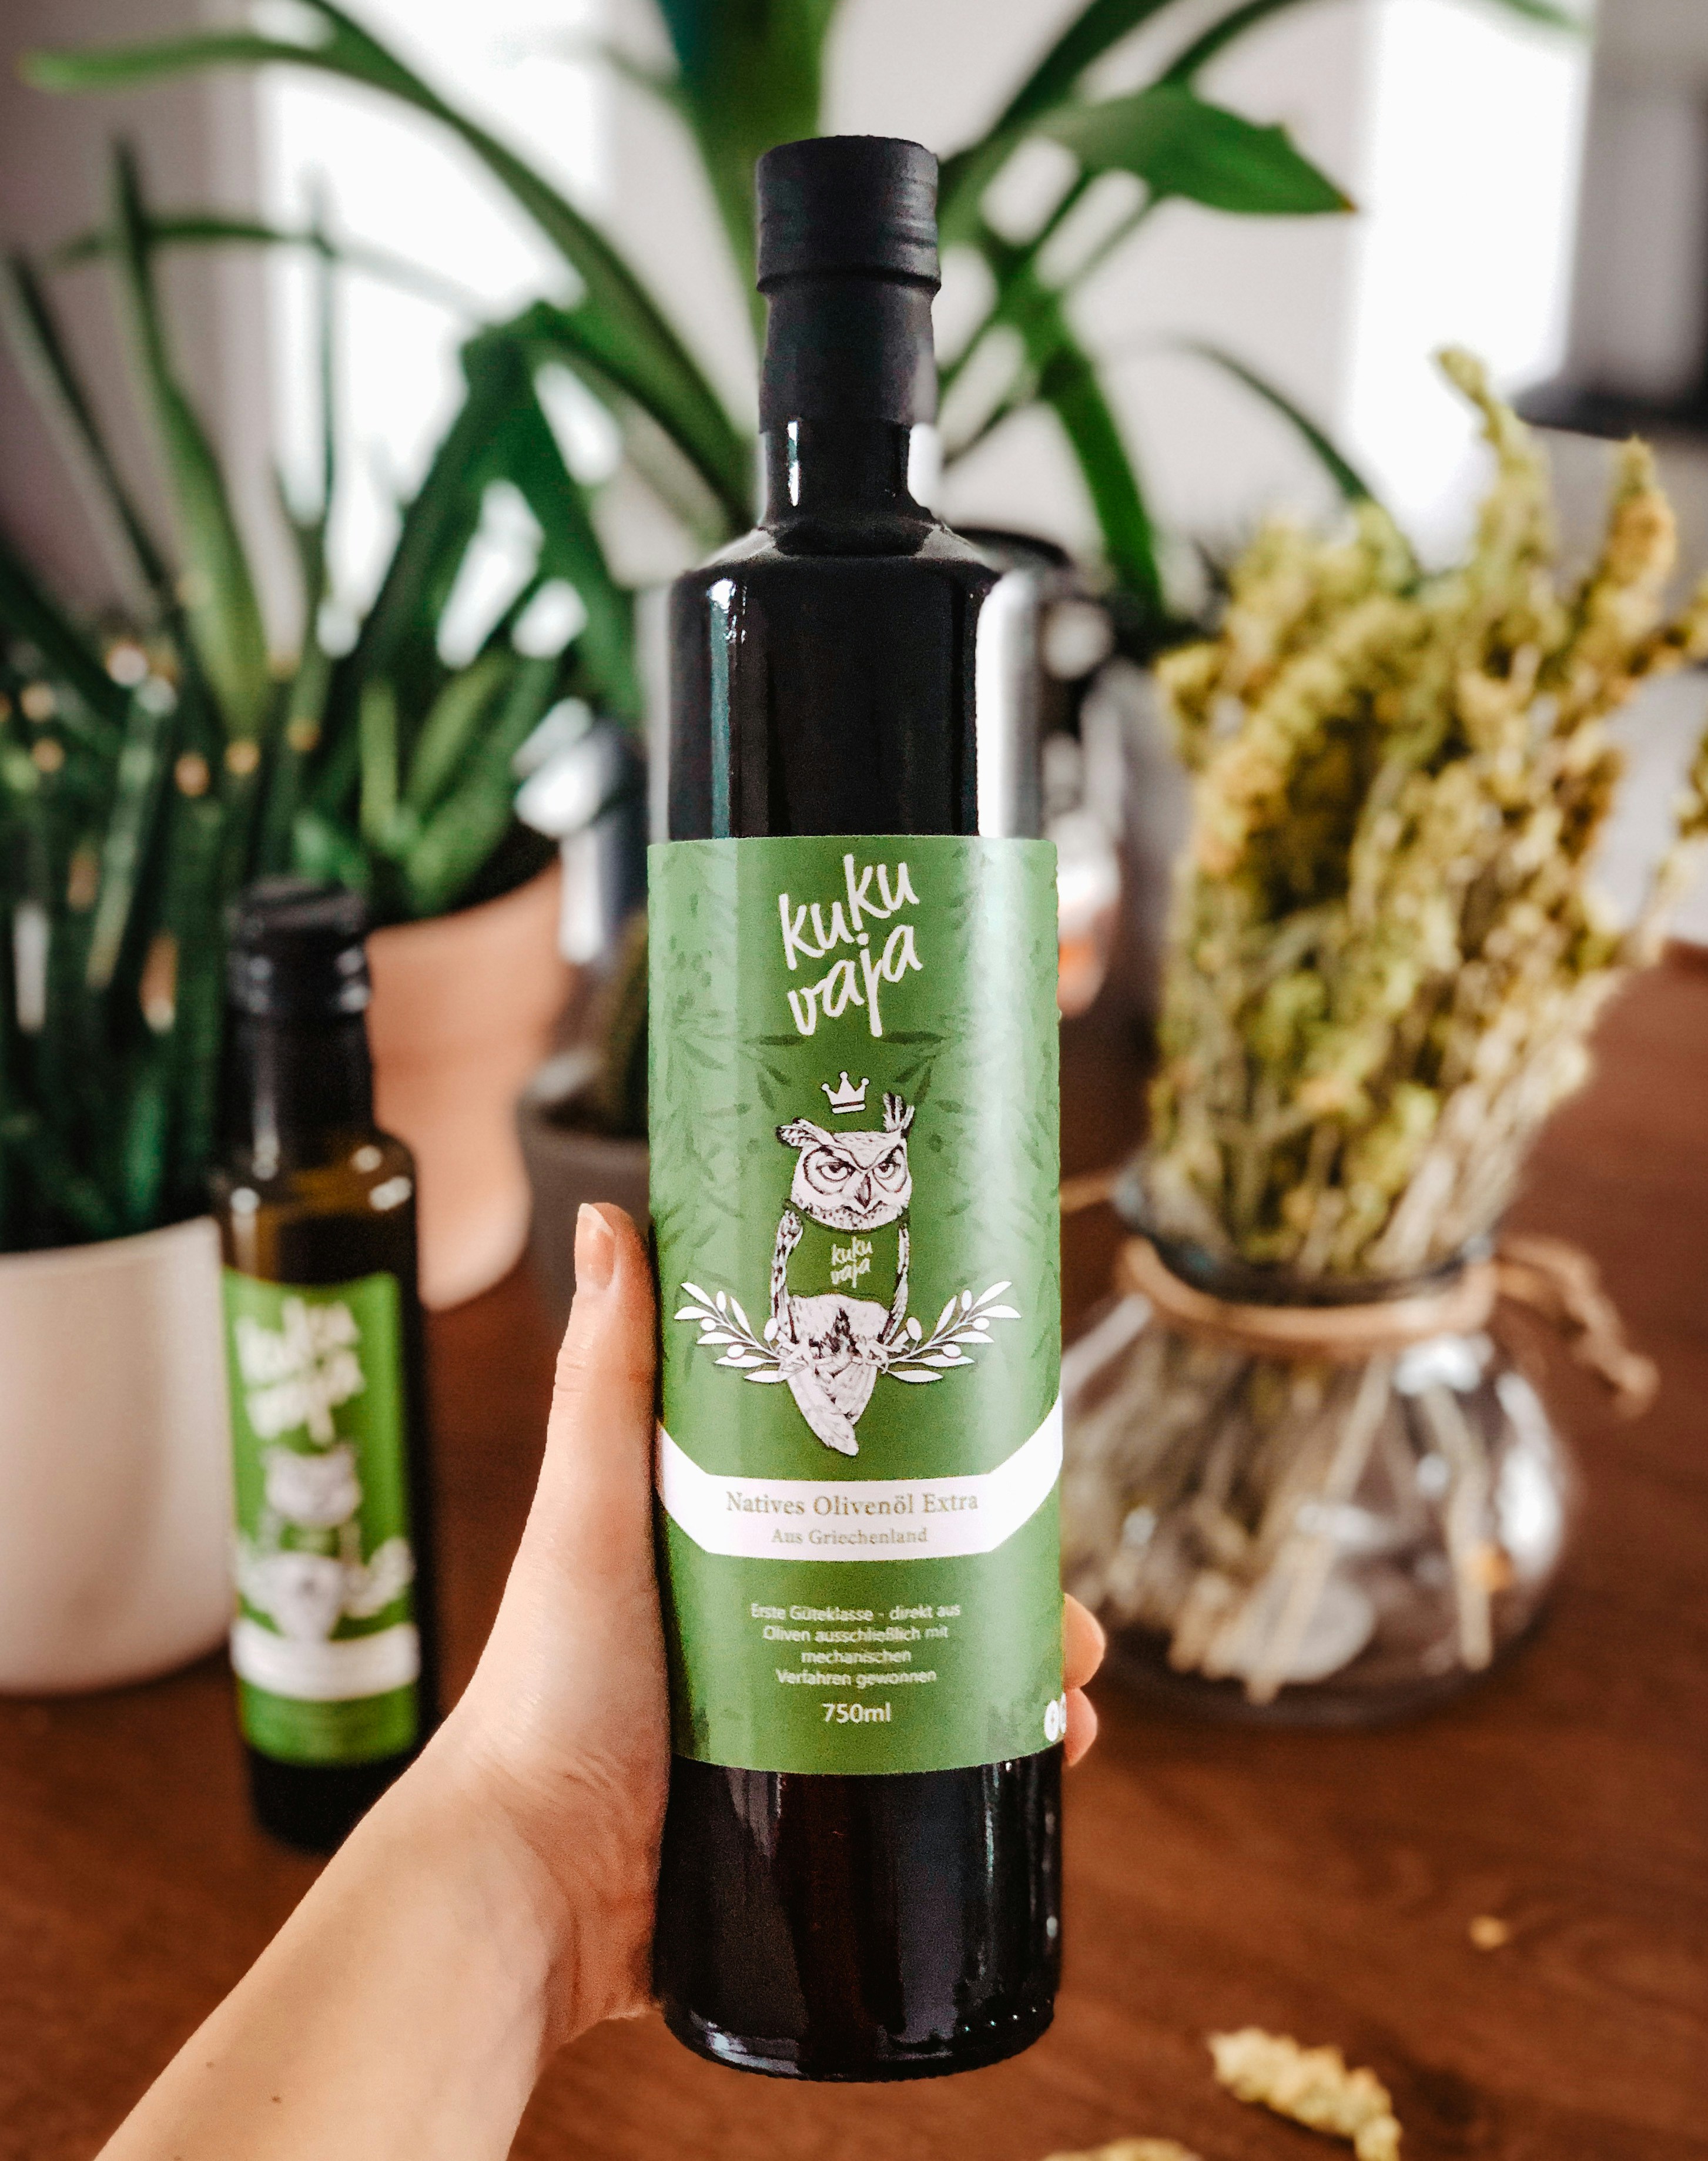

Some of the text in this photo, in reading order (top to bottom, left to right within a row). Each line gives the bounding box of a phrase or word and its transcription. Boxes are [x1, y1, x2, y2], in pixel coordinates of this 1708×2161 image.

[778, 853, 919, 970] kuku
[787, 924, 922, 1037] vaja
[831, 1235, 873, 1266] kuku
[830, 1258, 870, 1289] vaja
[726, 1491, 978, 1516] Natives Olivenöl Extra
[771, 1526, 928, 1544] Aus Griechenland
[751, 1603, 786, 1620] Erste
[789, 1604, 874, 1621] Güteklasse
[889, 1605, 933, 1620] direkt
[937, 1604, 961, 1617] aus
[763, 1625, 949, 1643] Oliven ausschließlich mit
[801, 1649, 912, 1664] mechanischen
[775, 1669, 937, 1690] Verfahren gewonnen
[822, 1701, 891, 1724] 750ml
